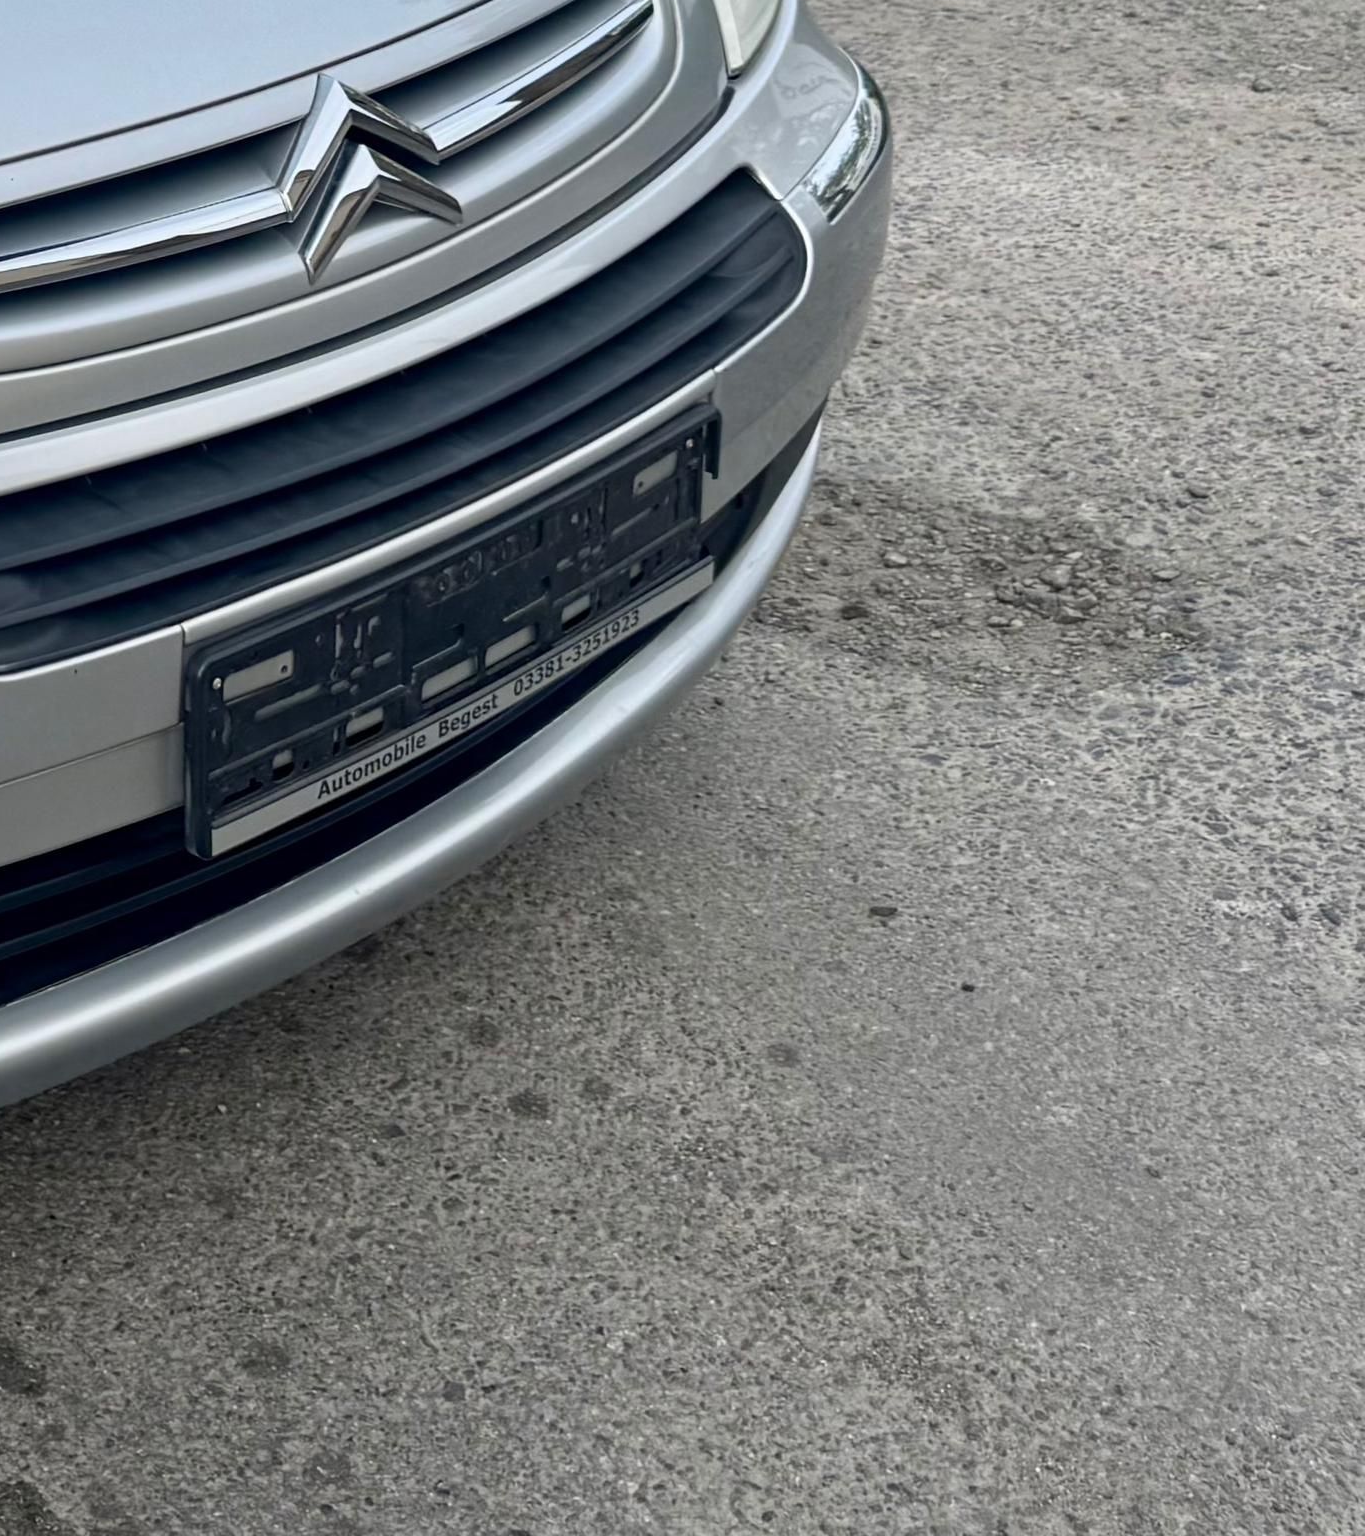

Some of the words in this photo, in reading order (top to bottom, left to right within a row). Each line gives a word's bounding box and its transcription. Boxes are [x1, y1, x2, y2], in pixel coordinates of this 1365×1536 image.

[317, 733, 427, 799] Automobile
[437, 694, 499, 738] Begest
[513, 609, 640, 697] 03381-3251923
